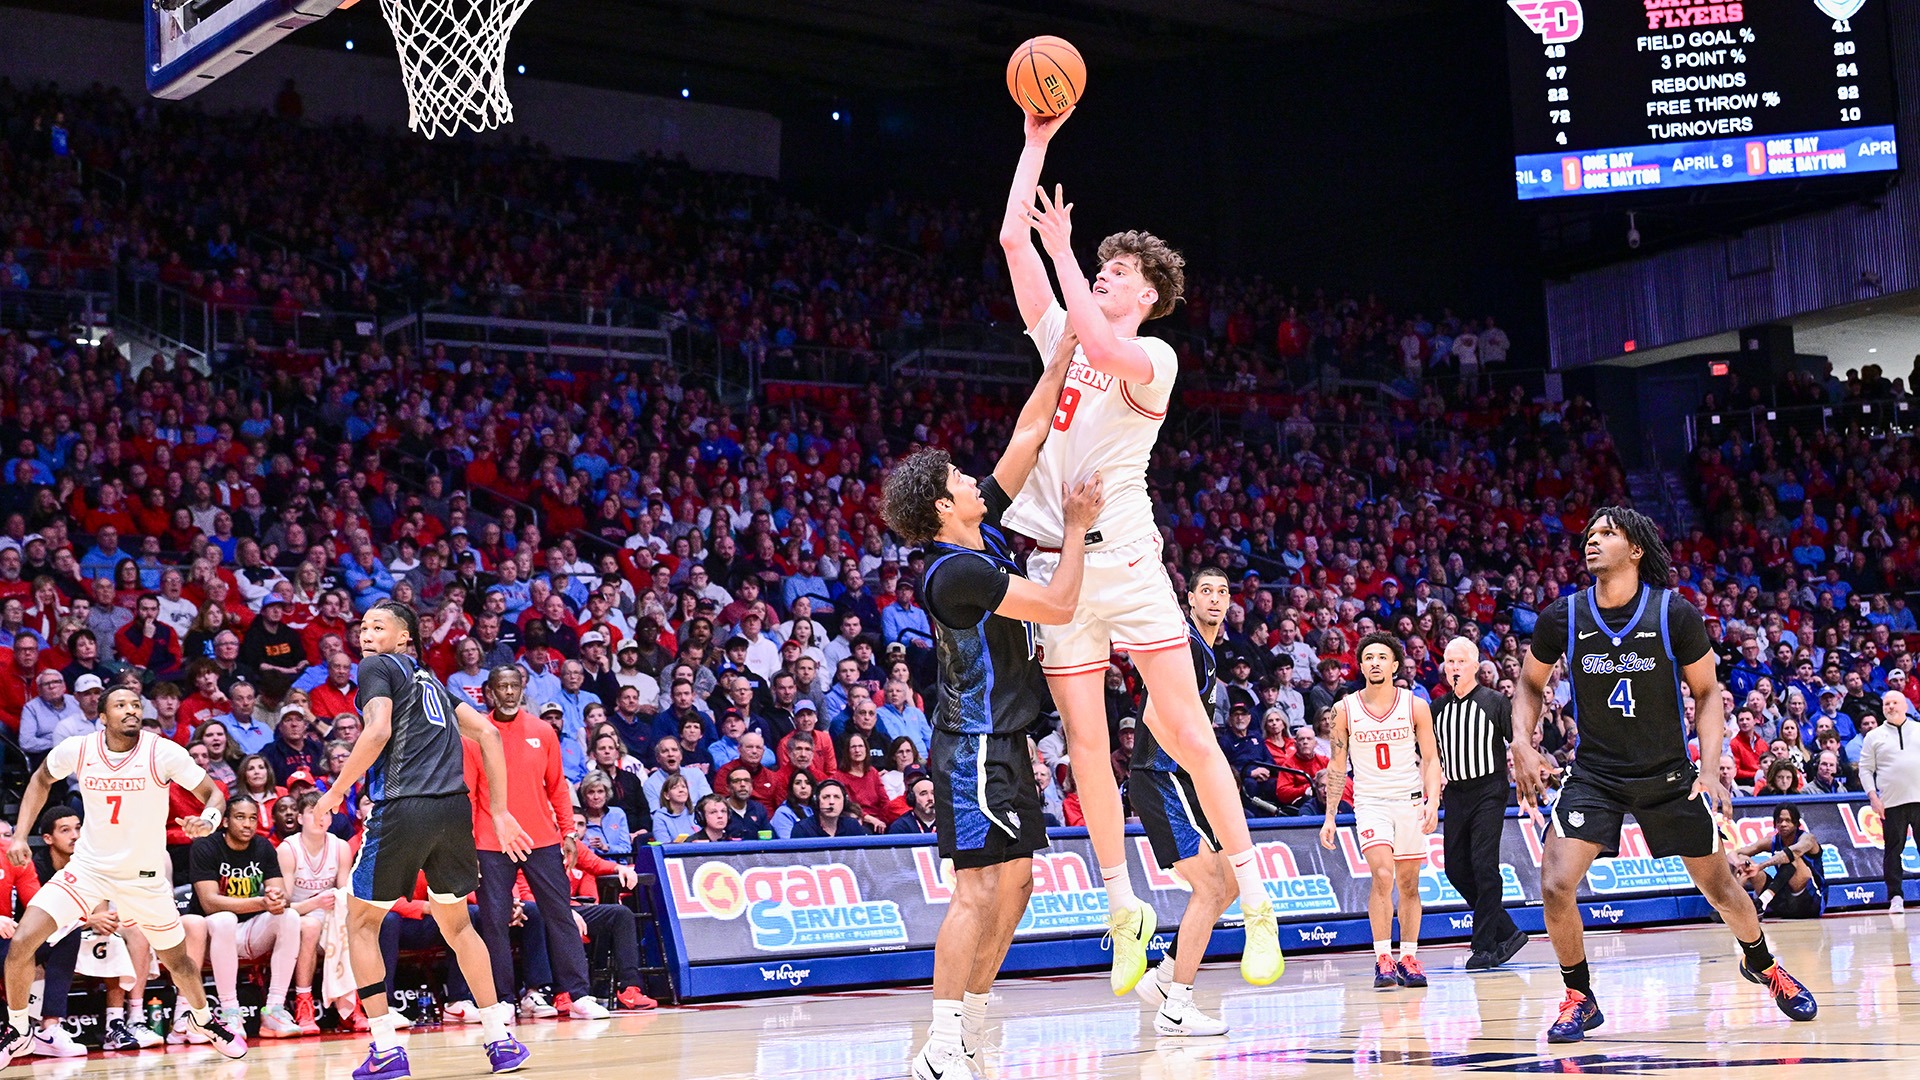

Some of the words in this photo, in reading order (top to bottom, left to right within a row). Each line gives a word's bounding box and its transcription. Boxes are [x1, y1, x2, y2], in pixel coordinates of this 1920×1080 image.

[1646, 3, 1743, 29] FLYERS
[1637, 33, 1685, 51] FIELD
[1689, 29, 1736, 47] GOAL
[1739, 27, 1755, 43] %
[1833, 41, 1855, 56] 20
[1661, 55, 1671, 70] 3
[1675, 49, 1727, 68] POINT
[1730, 48, 1746, 64] %
[1836, 62, 1858, 77] 24
[1546, 66, 1567, 80] 47
[1651, 72, 1746, 94] REBOUNDS
[1044, 74, 1069, 110] ELITE
[1646, 99, 1691, 116] FREE
[1694, 93, 1758, 112] THROW
[1840, 106, 1861, 121] 10
[1555, 131, 1567, 145] 4
[1647, 116, 1753, 139] TURNOVERS
[1766, 139, 1792, 156] ONE
[1793, 137, 1819, 153] DAY
[1858, 140, 1896, 157] APRI
[1582, 155, 1608, 171] ONE
[1609, 152, 1634, 168] DAY
[1672, 155, 1719, 172] APRIL
[1722, 154, 1733, 168] 8
[1768, 158, 1794, 174] ONE
[1795, 153, 1846, 172] DAYTON
[1516, 170, 1537, 185] RIL
[1541, 168, 1552, 183] 8
[1583, 172, 1609, 189] ONE
[1610, 168, 1660, 187] DAYTON
[1053, 386, 1081, 432] 9
[1582, 652, 1614, 674] The
[1613, 651, 1656, 674] Lou
[418, 681, 446, 728] 0
[1607, 678, 1636, 717] 4
[1354, 727, 1410, 743] DAYTON
[1375, 743, 1391, 770] 0
[85, 777, 145, 791] DAYTON
[106, 796, 122, 824] 7
[1588, 857, 1685, 890] SERVICES
[666, 859, 859, 916] Logan
[1856, 886, 1875, 904] Kroger
[1296, 900, 1332, 908] PLUMBING
[1601, 904, 1624, 923] Kroger
[751, 901, 897, 946] SERVICES
[823, 932, 845, 940] HEAT
[854, 929, 899, 938] PLUMBING
[1311, 926, 1337, 946] Kroger
[93, 942, 107, 959] G
[776, 964, 810, 985] Kroger
